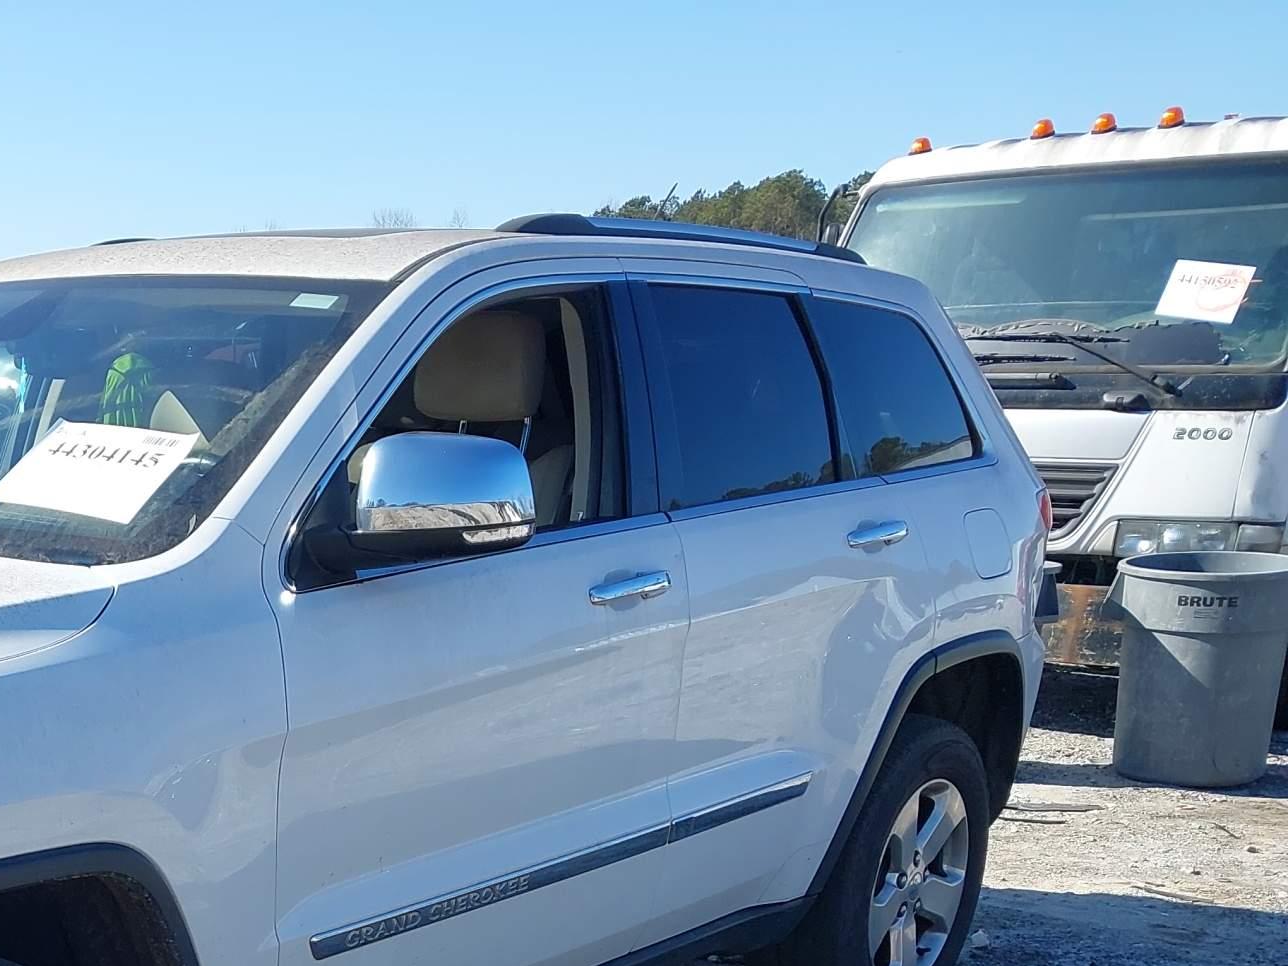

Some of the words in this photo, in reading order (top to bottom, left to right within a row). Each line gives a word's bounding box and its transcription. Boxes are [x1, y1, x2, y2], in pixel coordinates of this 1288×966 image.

[1172, 427, 1233, 441] 2000
[48, 441, 165, 468] 44304145
[1177, 595, 1240, 608] BRUTE
[345, 911, 422, 948] GRAND
[429, 875, 530, 921] CHEROKEE
